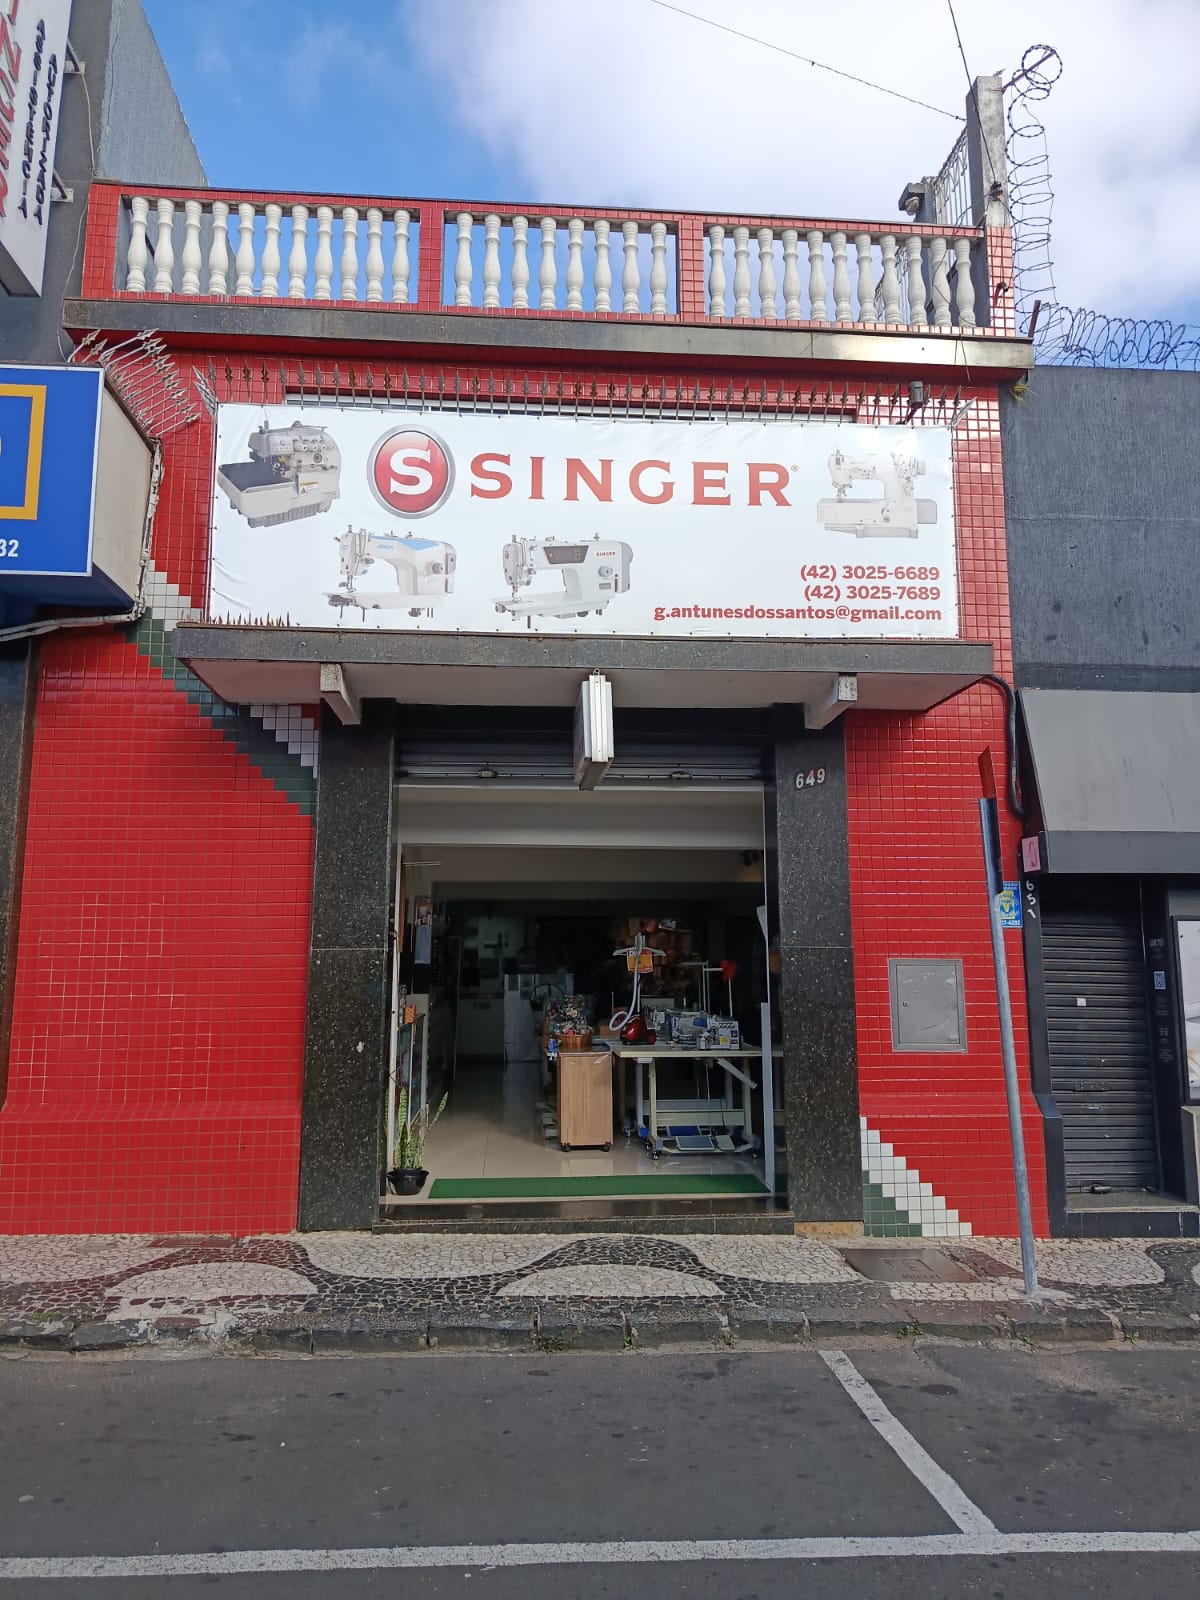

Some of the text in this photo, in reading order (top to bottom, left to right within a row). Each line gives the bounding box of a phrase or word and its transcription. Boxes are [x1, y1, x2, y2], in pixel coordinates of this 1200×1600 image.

[33, 52, 58, 226] AUTORIZADA
[800, 564, 940, 582] (42) 3025-6689
[804, 585, 941, 602] (42) 3025-7689
[653, 604, 942, 623] g.antunesdossantos@gmail.com
[795, 768, 826, 789] 649
